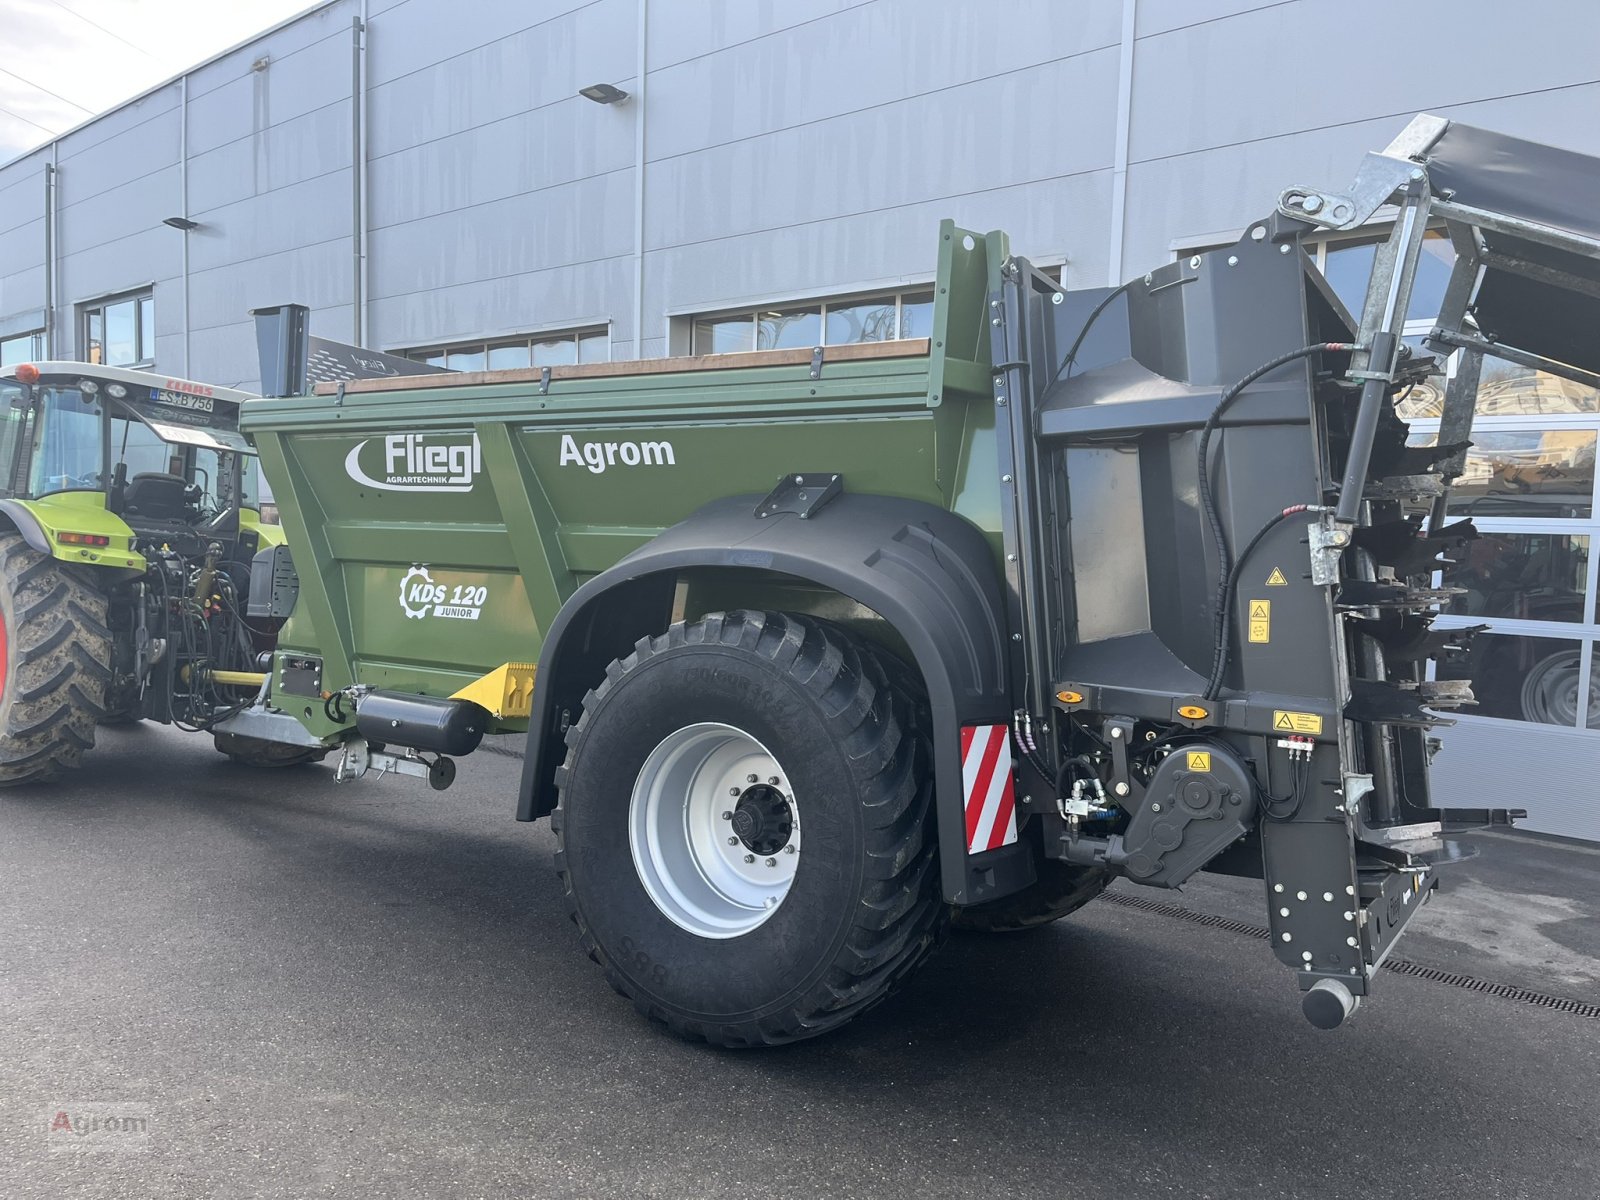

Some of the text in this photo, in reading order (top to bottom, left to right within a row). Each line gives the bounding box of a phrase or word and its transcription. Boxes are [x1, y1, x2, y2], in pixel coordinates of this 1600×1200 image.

[166, 379, 214, 396] CLAAS
[181, 394, 189, 406] B
[191, 396, 212, 411] 756
[385, 432, 481, 484] Fliegl
[559, 434, 676, 474] Agrom
[386, 476, 448, 484] AGRARTECHNIK
[408, 583, 488, 606] KDS 120
[440, 607, 473, 618] JUNIOR
